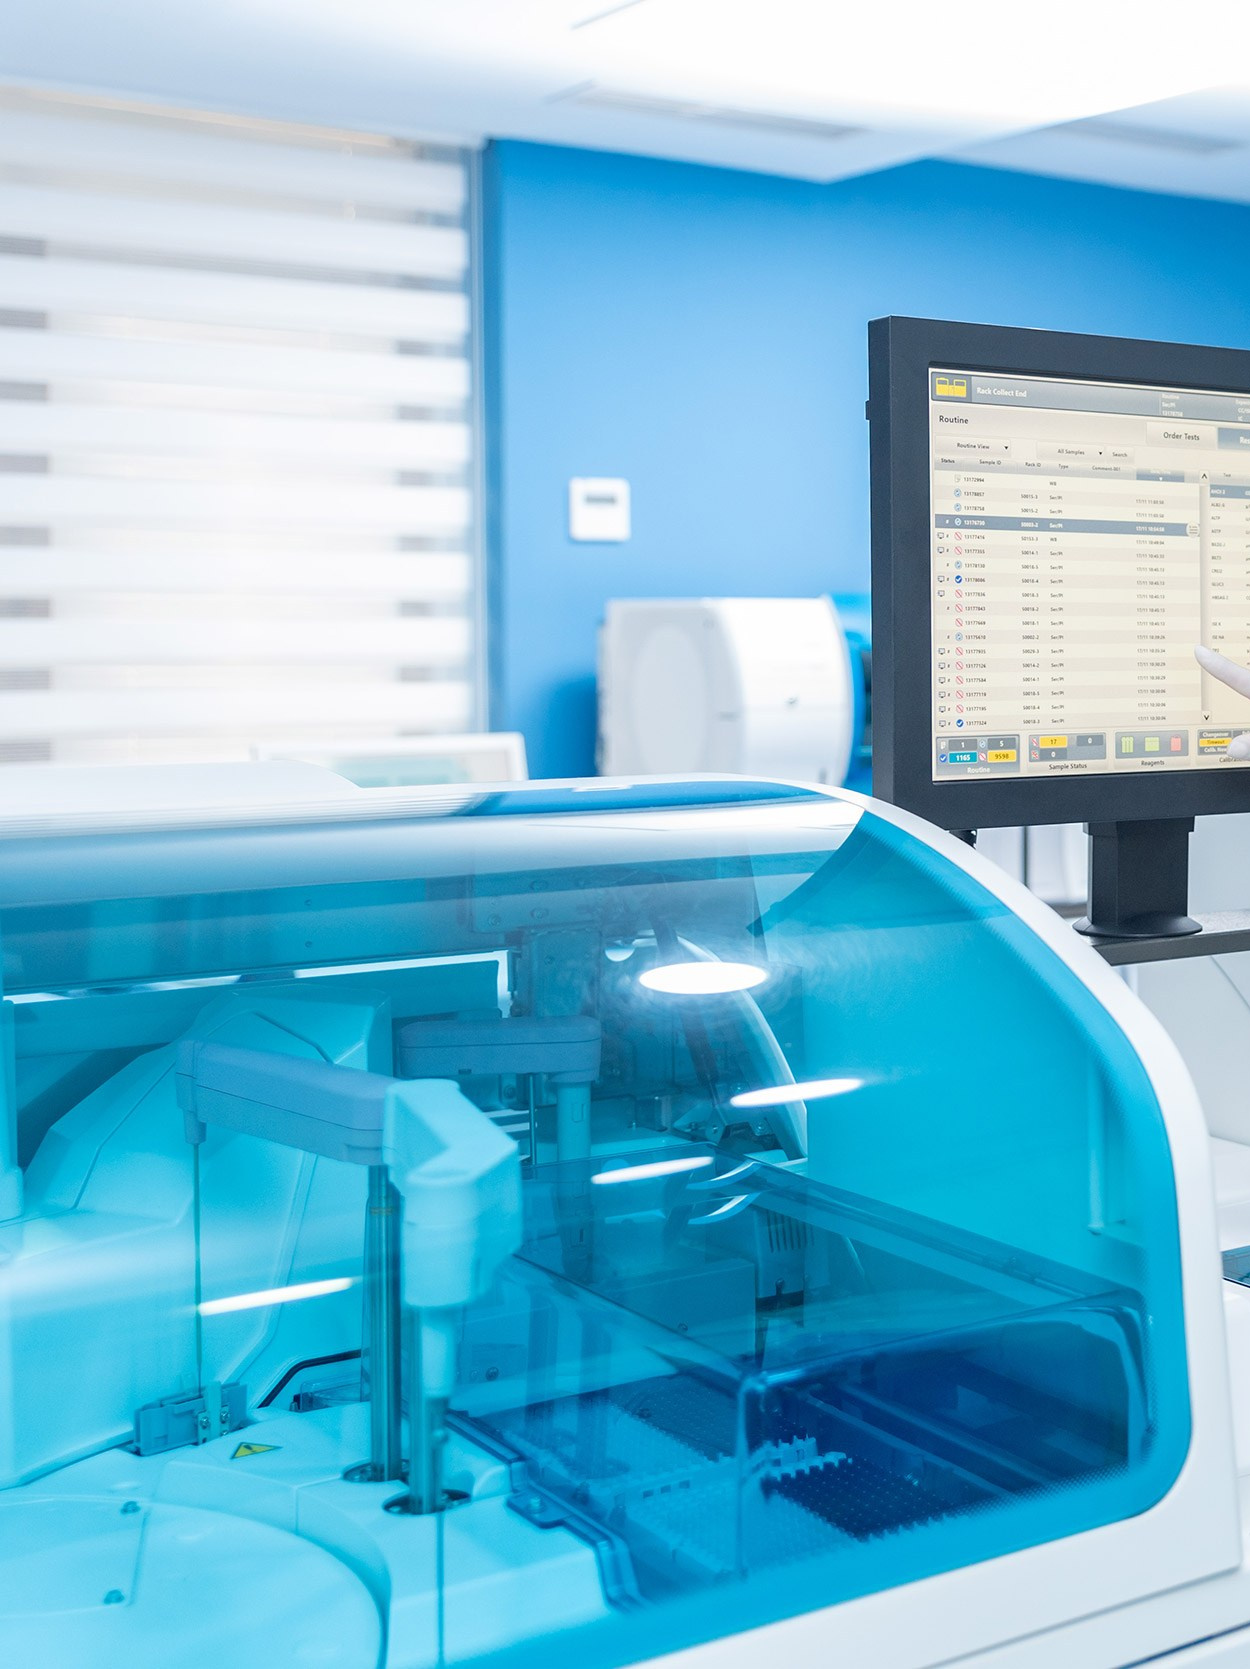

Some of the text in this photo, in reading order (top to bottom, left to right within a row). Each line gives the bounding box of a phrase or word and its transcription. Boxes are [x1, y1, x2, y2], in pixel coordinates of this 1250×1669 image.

[976, 387, 1027, 398] Rack Collect End
[939, 414, 969, 425] Routine
[1163, 431, 1200, 441] Order Tests
